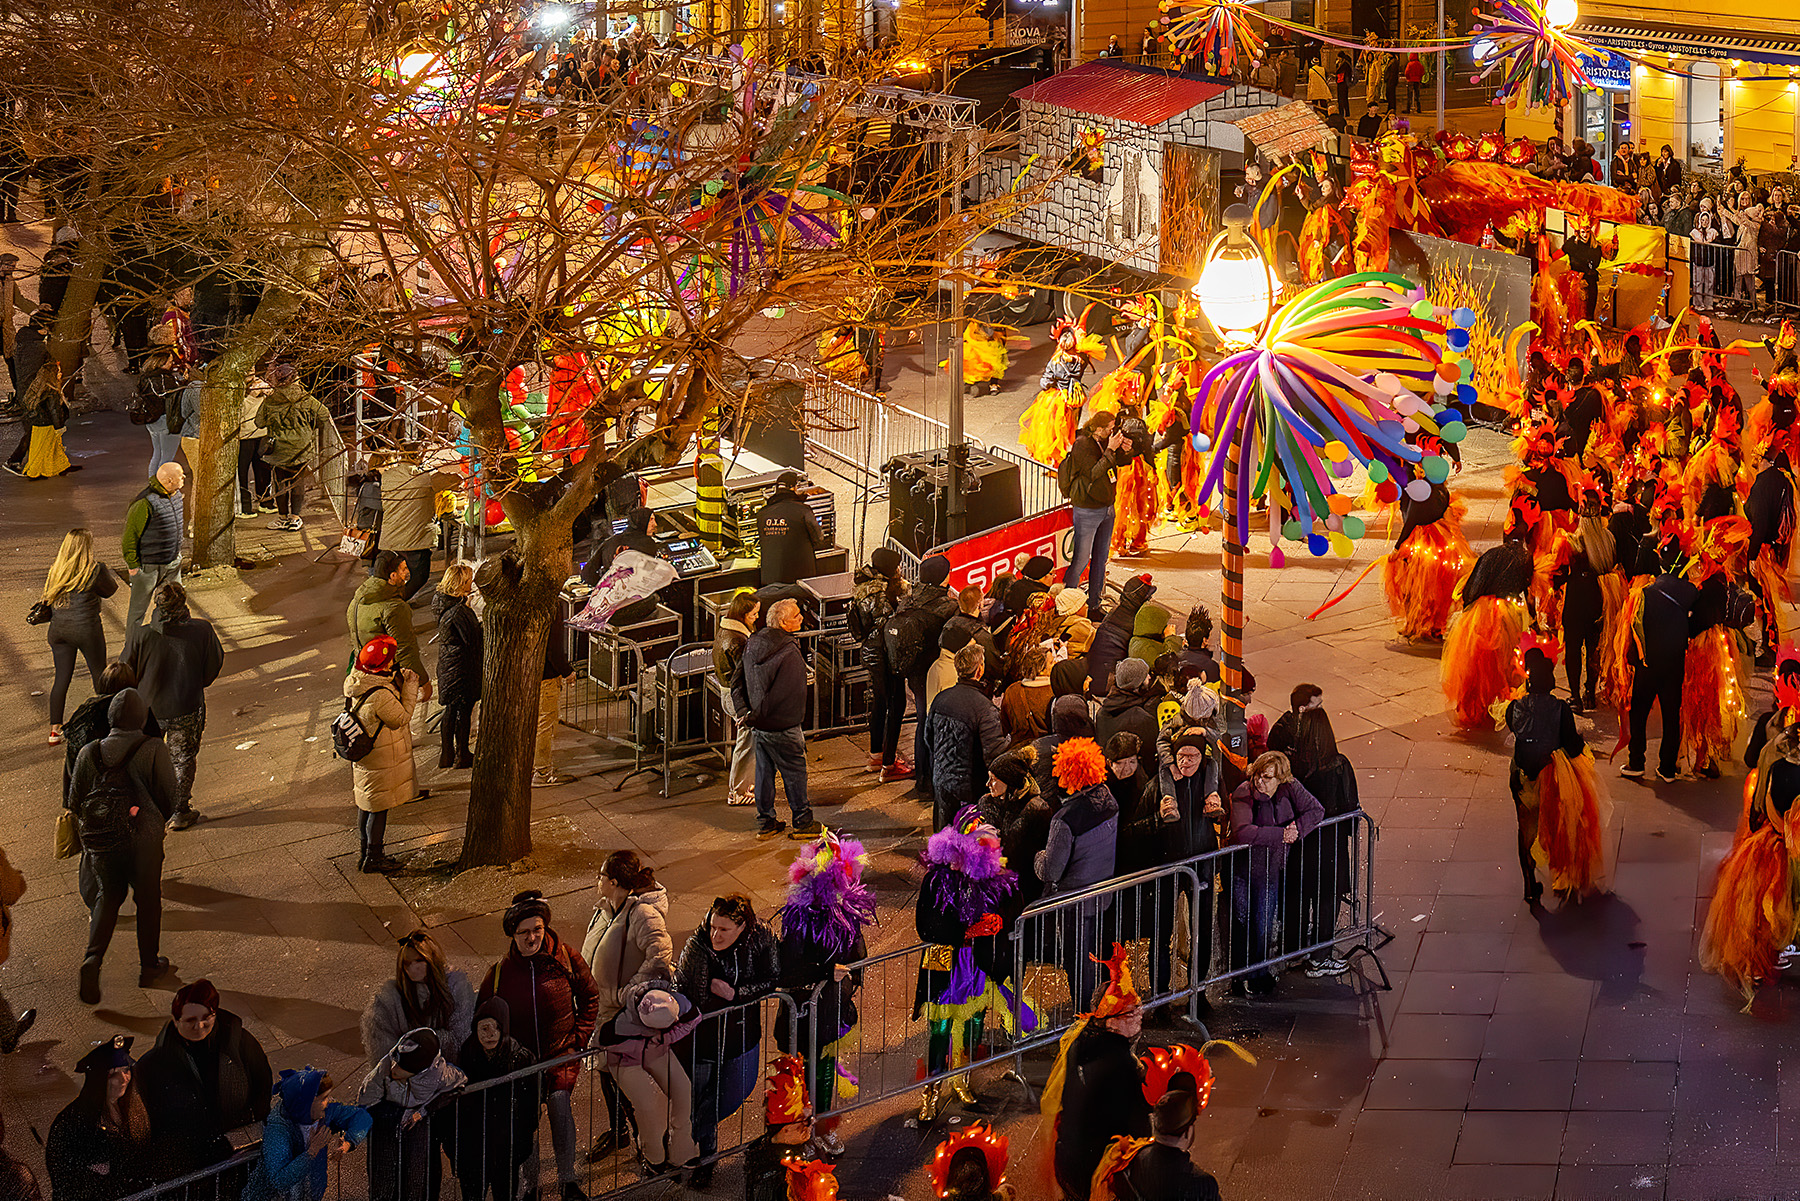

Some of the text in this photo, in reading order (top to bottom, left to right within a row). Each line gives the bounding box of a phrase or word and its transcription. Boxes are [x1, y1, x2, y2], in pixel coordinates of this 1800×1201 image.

[1010, 27, 1041, 38] NOVA
[1588, 35, 1728, 57] Gyros ARISTOTELES Gyros ARISTOTELES Gyros
[1581, 66, 1631, 80] ARISTOTELES
[967, 541, 1054, 590] SPR
